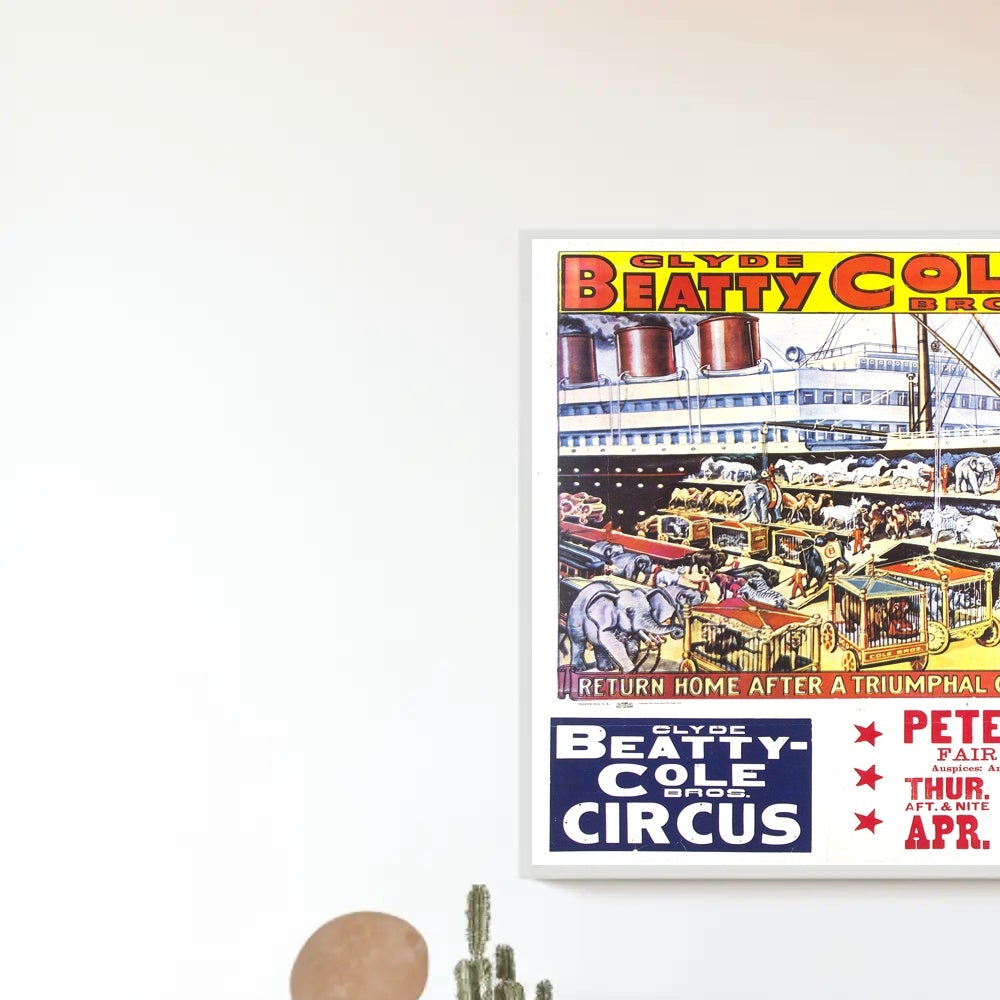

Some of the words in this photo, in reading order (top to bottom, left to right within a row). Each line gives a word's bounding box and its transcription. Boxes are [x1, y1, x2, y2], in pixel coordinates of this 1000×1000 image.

[629, 254, 804, 268] CLYDE
[561, 254, 820, 312] BEATTY
[869, 650, 892, 660] COLE
[578, 676, 665, 697] RETURN
[675, 676, 740, 697] HOME
[748, 675, 823, 696] AFTER
[830, 675, 848, 694] A
[851, 674, 988, 695] TRIUMPHAL
[652, 725, 746, 735] CLYDE
[555, 724, 808, 760] BEATTY-
[937, 748, 998, 762] FAIR
[932, 764, 983, 774] Auspices:
[598, 763, 766, 798] COLE
[905, 777, 990, 801] THUR.
[664, 788, 751, 799] BROS.
[905, 802, 938, 812] AFT.
[941, 802, 952, 812] &
[955, 802, 990, 812] NITE
[562, 802, 802, 845] CIRCUS
[905, 815, 990, 850] APR.
